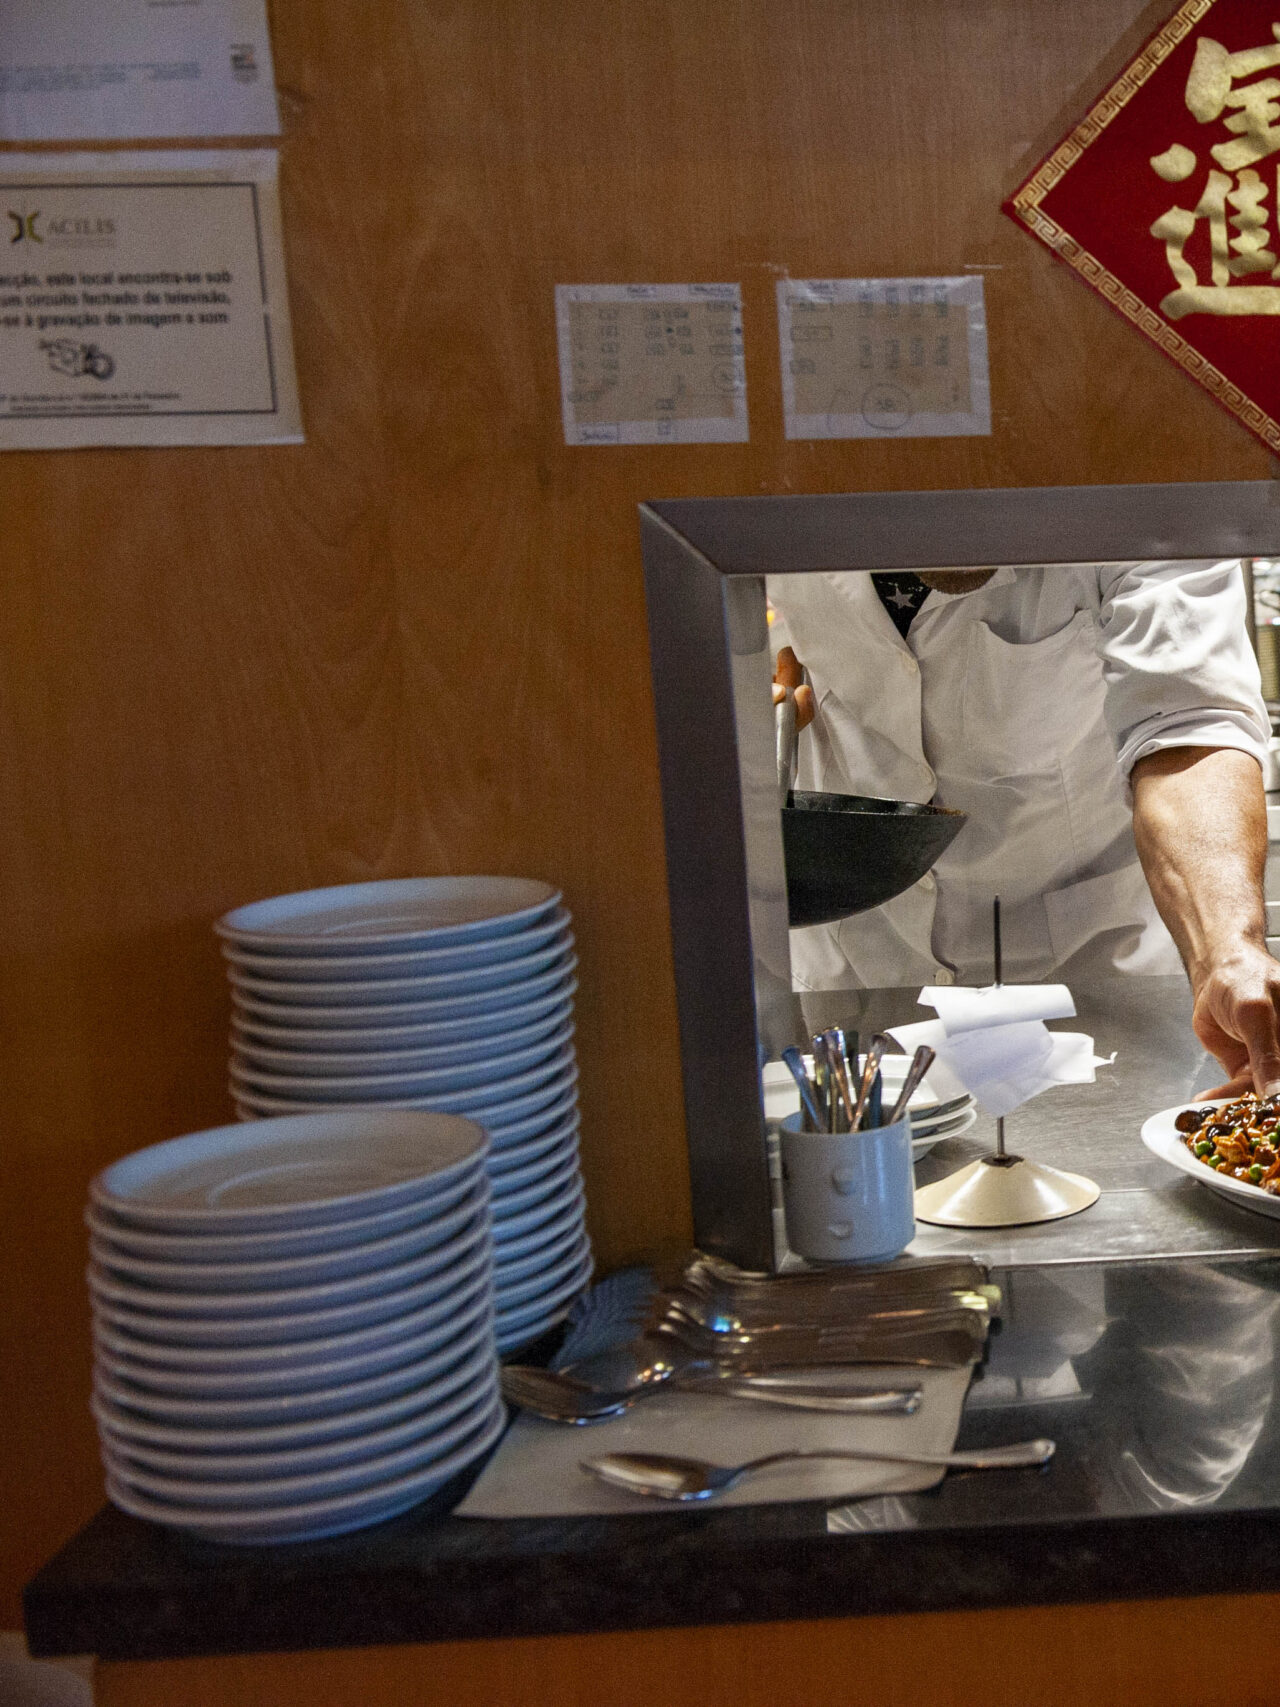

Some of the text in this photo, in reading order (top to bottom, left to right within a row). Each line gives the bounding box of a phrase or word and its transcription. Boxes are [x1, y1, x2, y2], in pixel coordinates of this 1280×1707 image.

[45, 273, 76, 287] este
[79, 270, 114, 286] local
[205, 268, 233, 284] sob
[26, 293, 78, 307] circuito
[83, 291, 140, 306] fechado
[143, 291, 161, 305] de
[105, 312, 122, 327] de
[126, 312, 182, 329] imagem
[198, 311, 231, 325] som
